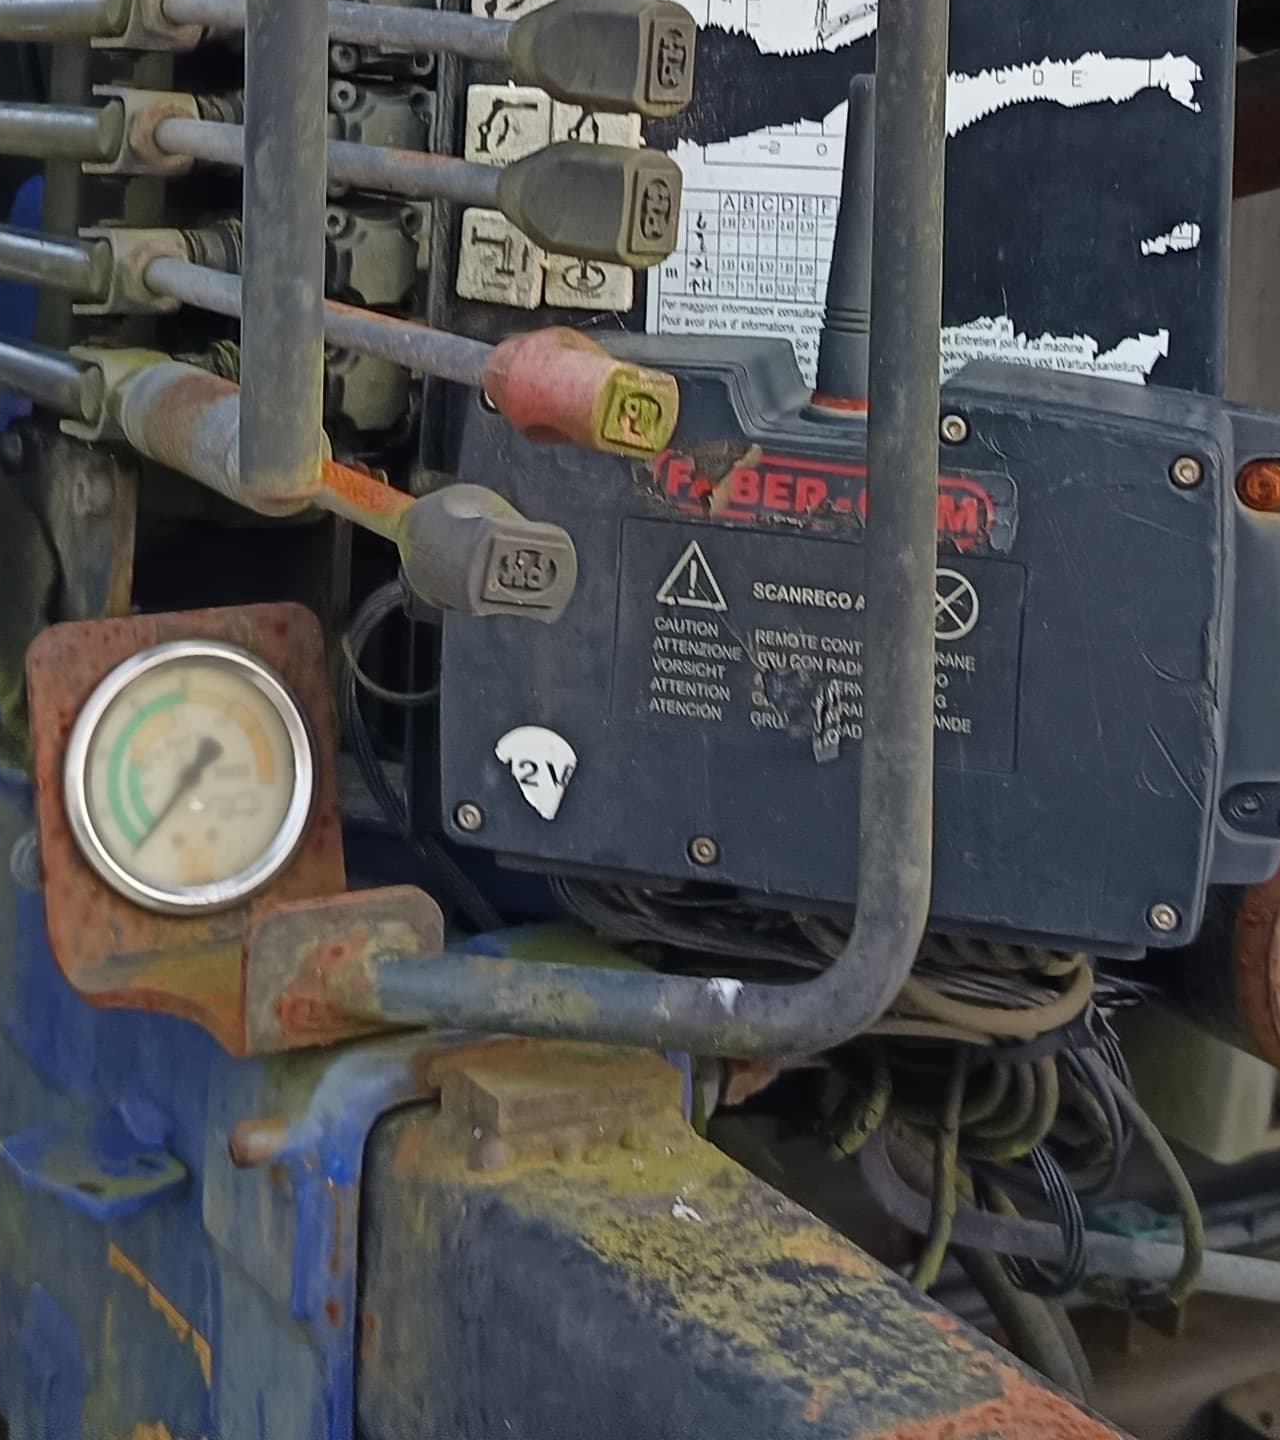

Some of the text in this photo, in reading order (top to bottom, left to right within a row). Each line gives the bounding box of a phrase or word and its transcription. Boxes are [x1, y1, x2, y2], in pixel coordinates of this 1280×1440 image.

[1033, 69, 1045, 86] D
[1072, 69, 1083, 88] E
[723, 193, 736, 211] A
[743, 195, 755, 211] B
[761, 196, 775, 212] C
[781, 196, 795, 213] D
[662, 313, 681, 327] Pour
[752, 581, 852, 610] SCANRECO
[653, 615, 719, 638] CAUTION
[652, 635, 743, 661] ATTENZIONE
[755, 628, 864, 656] REMOTE CONT
[651, 654, 726, 680] VORSICHT
[789, 653, 823, 673] CON
[649, 675, 731, 702] ATTENTION
